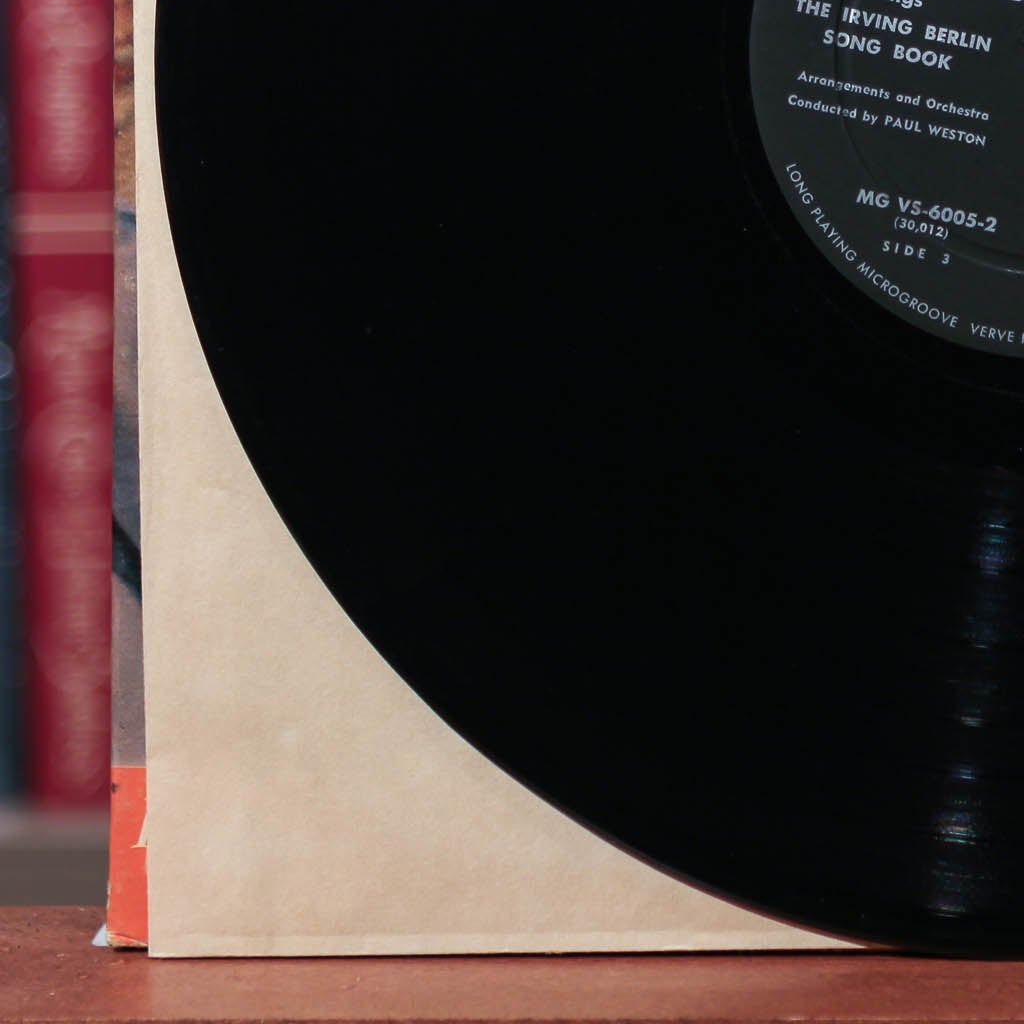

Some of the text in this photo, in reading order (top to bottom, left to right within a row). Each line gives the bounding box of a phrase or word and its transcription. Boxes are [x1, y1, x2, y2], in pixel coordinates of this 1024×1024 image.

[822, 29, 953, 70] SONG BOOK
[842, 6, 913, 35] IRVING
[924, 24, 992, 53] BERLIN
[797, 71, 990, 121] Arrangements and Orchestra
[787, 94, 987, 147] Conducted by PAUL WESTON
[856, 188, 998, 233] MG VS-6005-2
[785, 162, 814, 206] LONG
[810, 206, 858, 263] PLAYING
[856, 261, 960, 329] MICROGROOVE
[970, 322, 1016, 344] VERVE
[882, 240, 951, 265] SIDE 3
